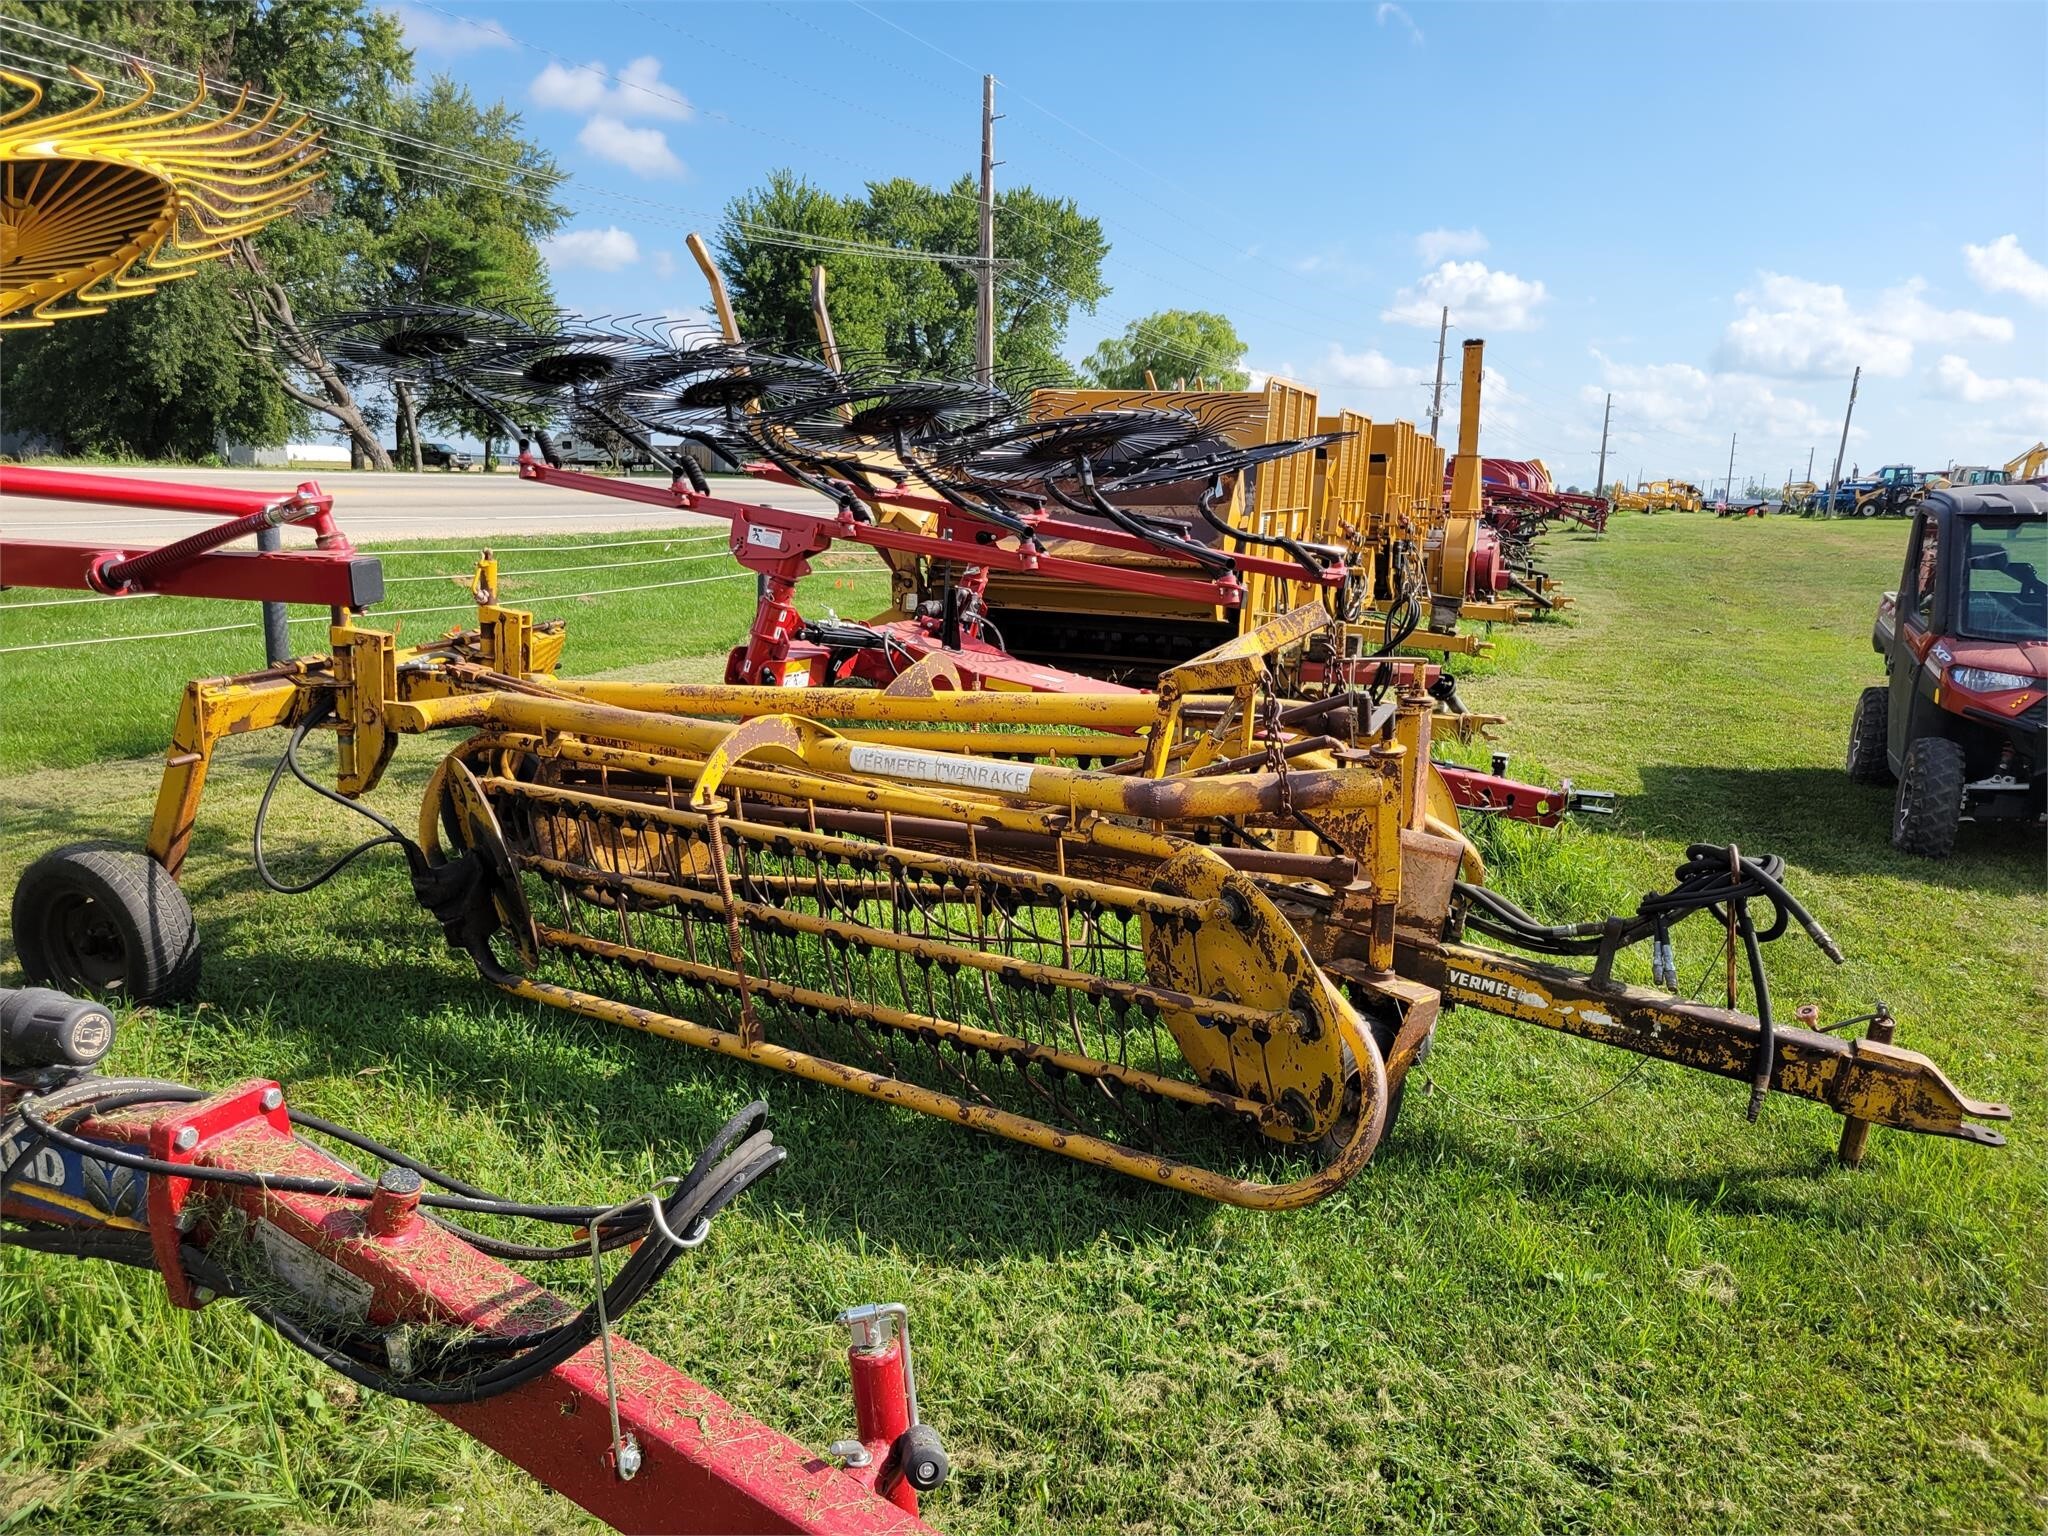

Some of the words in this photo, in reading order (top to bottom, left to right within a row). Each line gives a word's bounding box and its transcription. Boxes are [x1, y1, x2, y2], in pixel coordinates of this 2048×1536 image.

[1931, 645, 1952, 661] XP
[854, 753, 927, 773] VERMEER
[936, 762, 1026, 786] TWINRAKE
